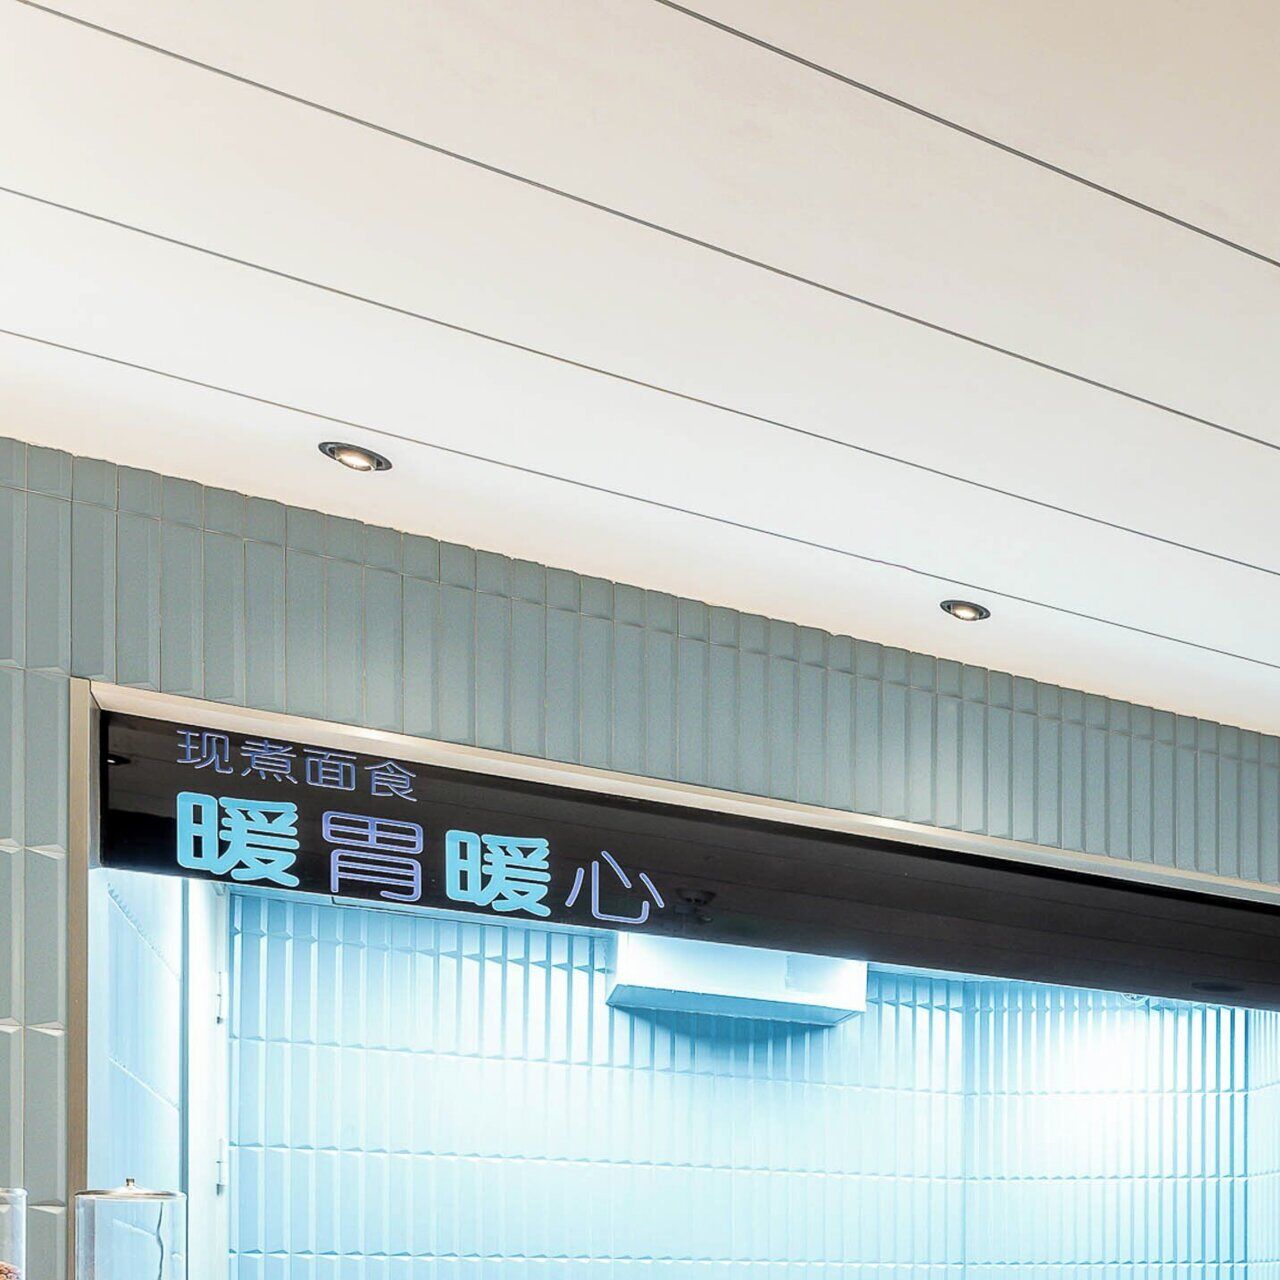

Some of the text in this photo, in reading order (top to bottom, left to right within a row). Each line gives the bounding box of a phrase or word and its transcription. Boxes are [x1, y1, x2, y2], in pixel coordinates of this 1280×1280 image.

[176, 730, 418, 802] 现煮面食
[175, 791, 665, 925] 暖胃暖心
